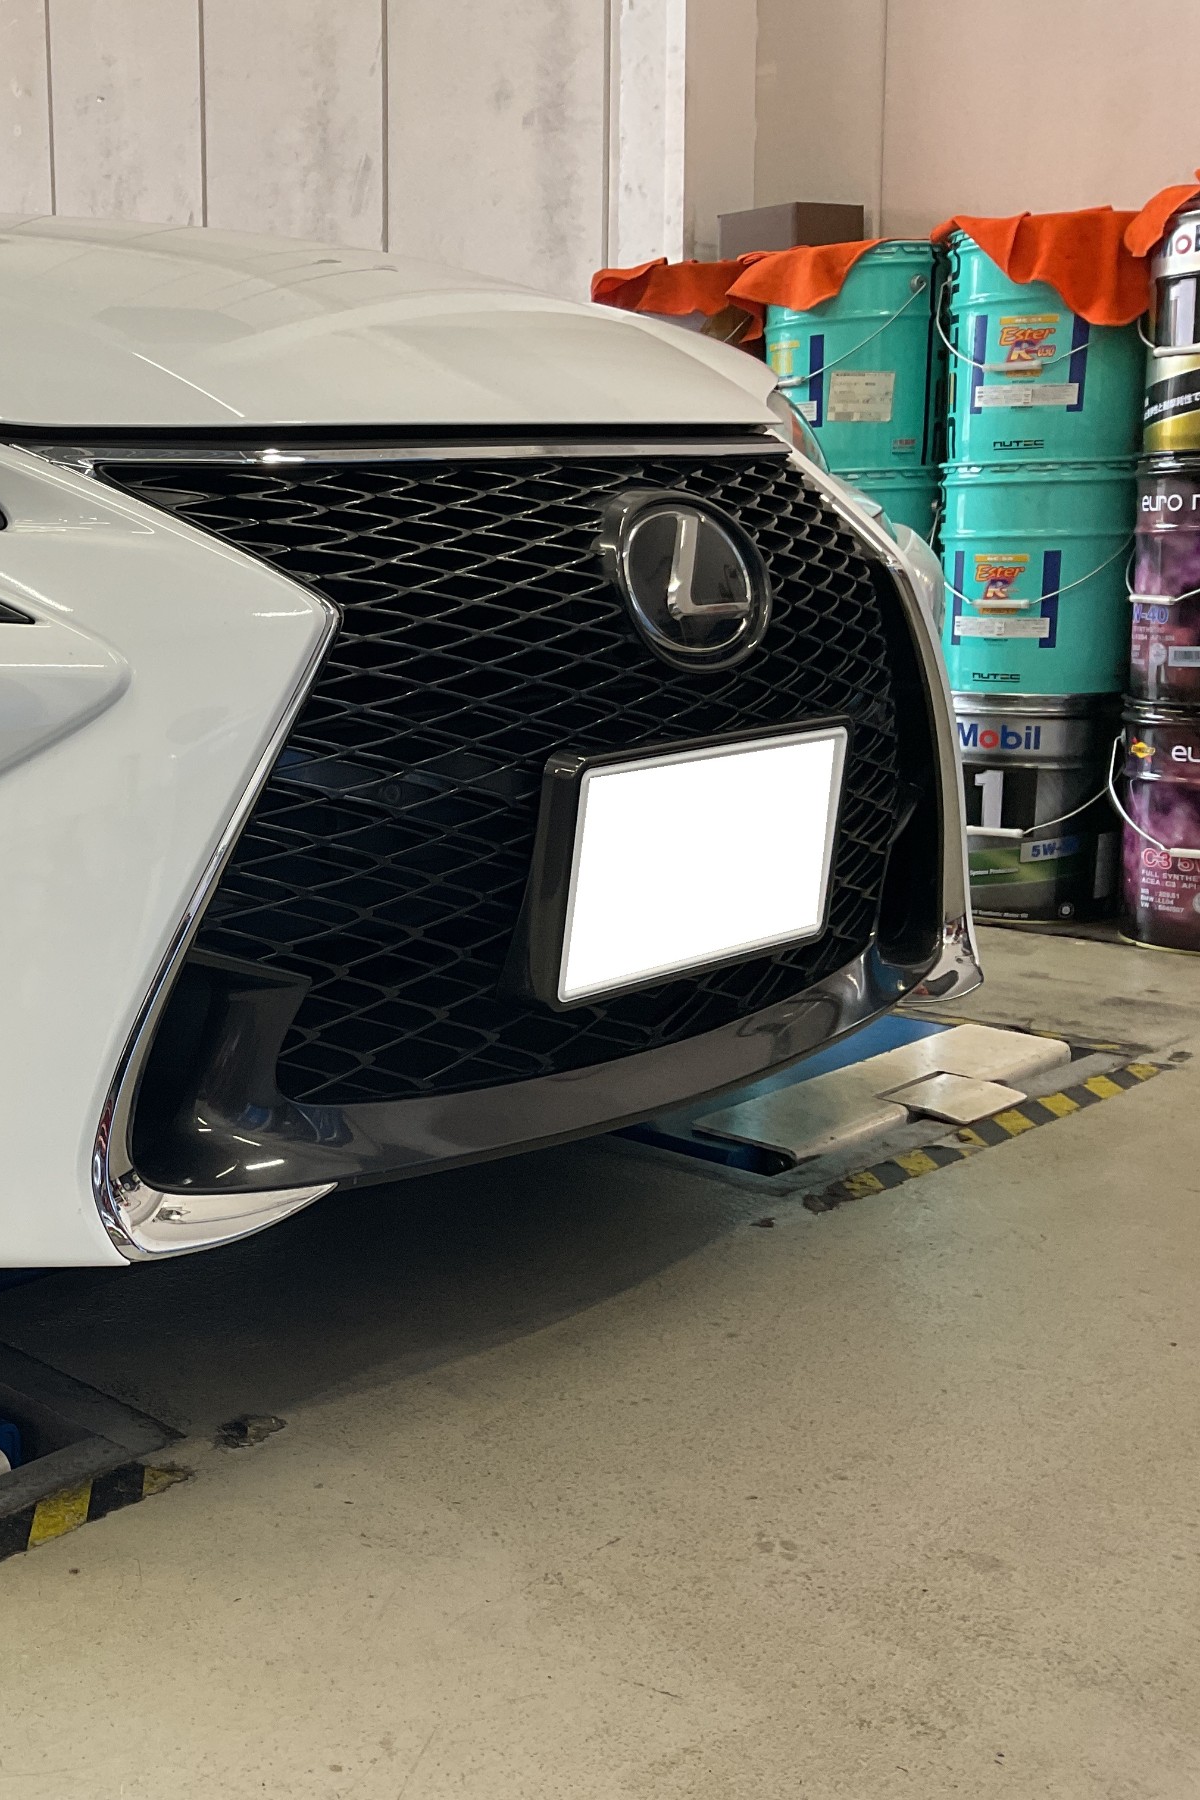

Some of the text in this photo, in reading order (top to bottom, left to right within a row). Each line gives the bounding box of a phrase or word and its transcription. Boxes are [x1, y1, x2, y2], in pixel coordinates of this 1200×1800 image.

[999, 327, 1056, 346] Ester
[993, 439, 1045, 448] NUTEC
[1142, 494, 1182, 512] euro
[975, 564, 1025, 582] Ester
[972, 672, 1020, 681] NUTEC
[957, 723, 1041, 750] Mobil
[974, 769, 1004, 828] 1
[1143, 848, 1172, 870] C3
[1141, 868, 1159, 878] FULL
